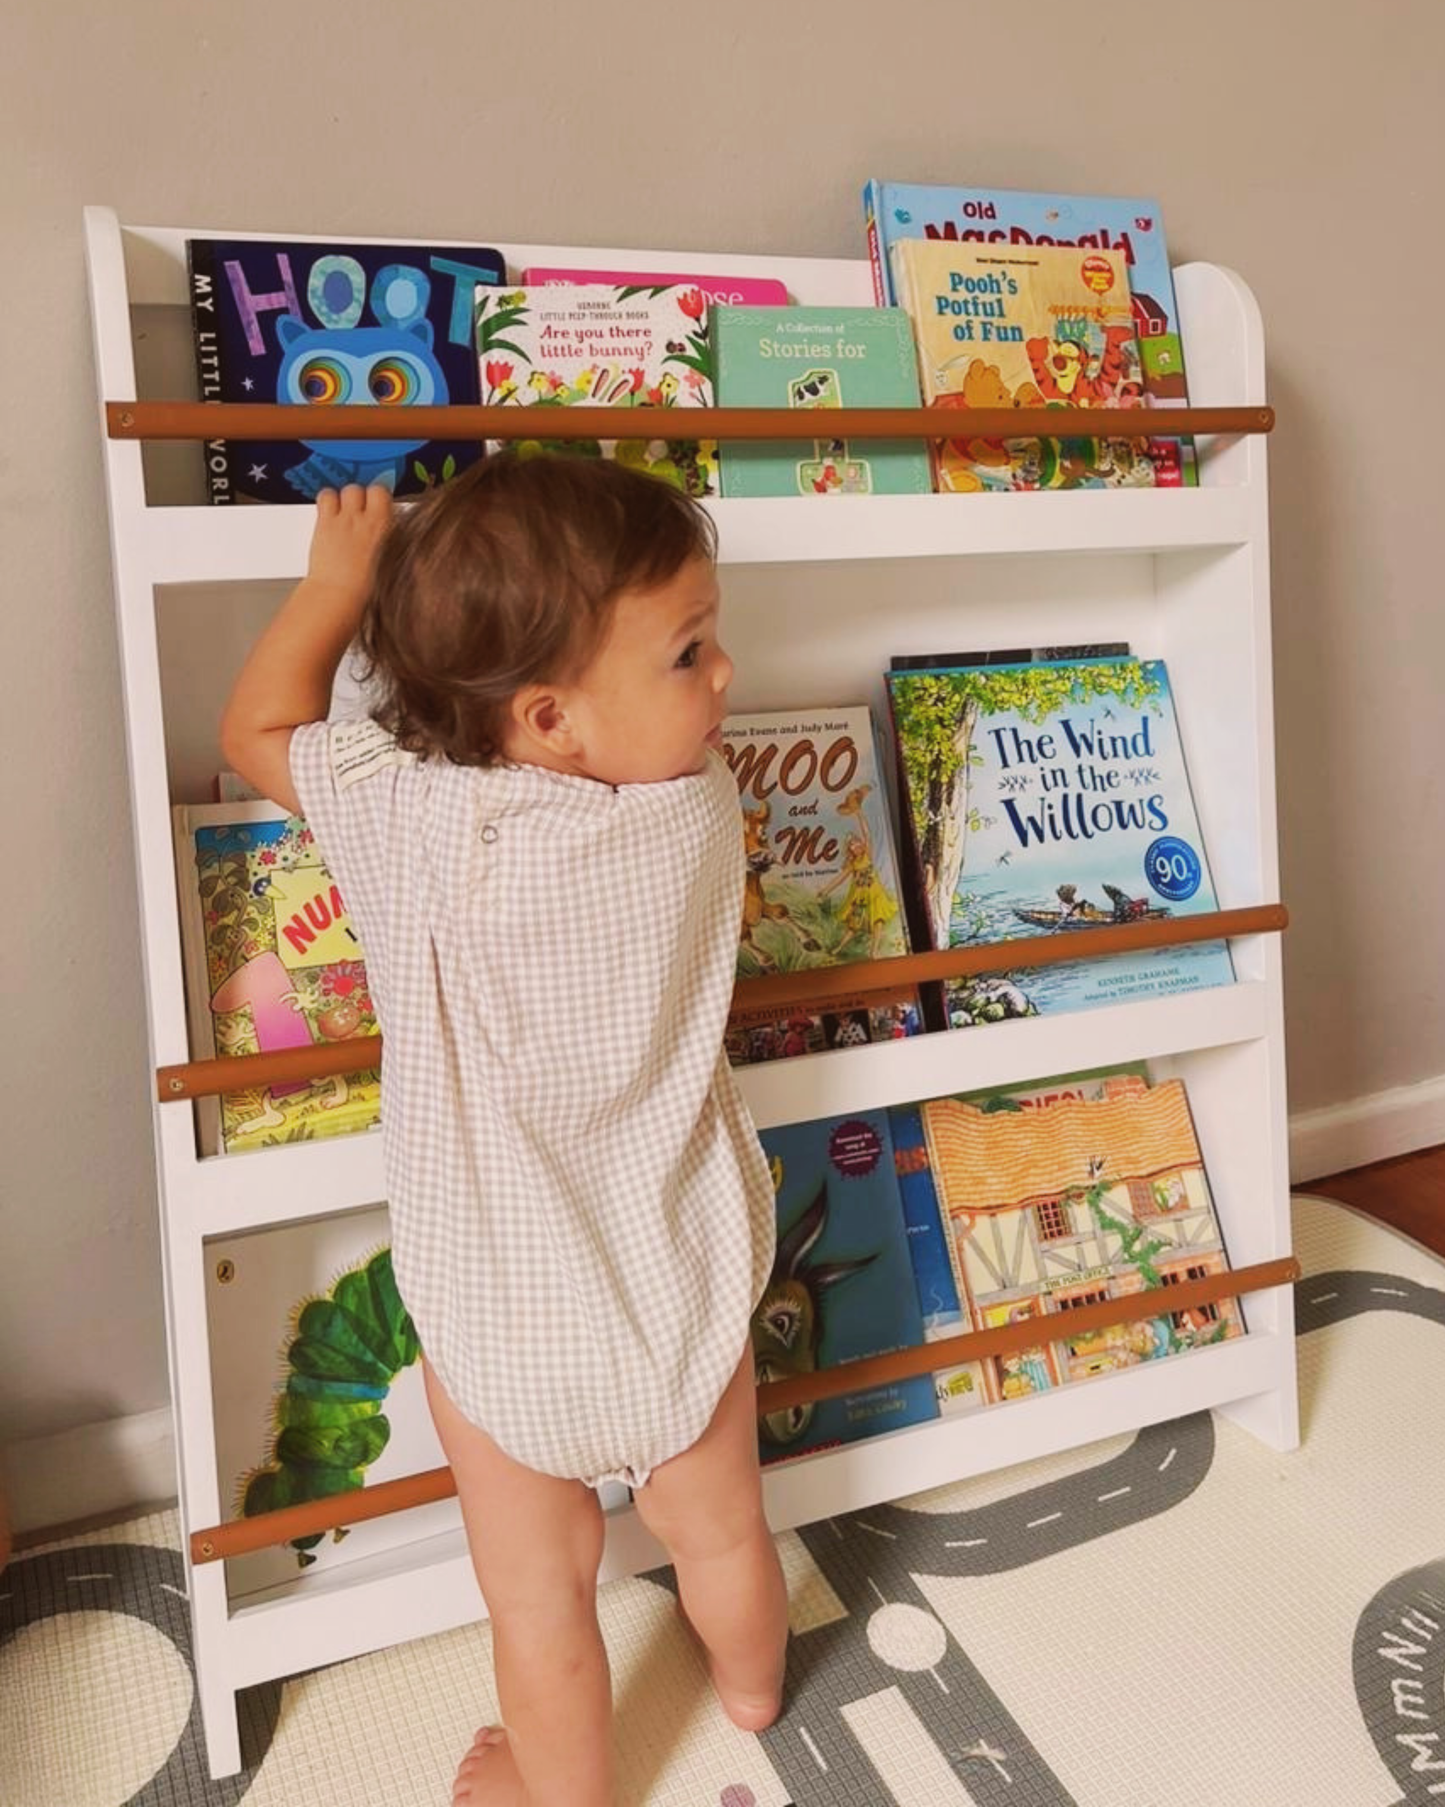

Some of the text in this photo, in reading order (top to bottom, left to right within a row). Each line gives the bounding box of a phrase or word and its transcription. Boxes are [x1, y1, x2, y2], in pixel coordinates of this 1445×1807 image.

[963, 202, 996, 219] Old
[195, 274, 214, 312] MY
[949, 271, 1019, 295] Pooh's
[223, 253, 499, 356] HOOT
[936, 296, 1006, 318] Potful
[540, 312, 566, 321] LITTLE
[775, 322, 845, 334] A Collection of
[539, 324, 652, 343] Are you there
[953, 319, 1025, 342] of Fun
[540, 340, 654, 362] little bunny?
[759, 338, 867, 358] Stories for
[200, 332, 222, 404] LITTL
[780, 725, 798, 735] and
[801, 722, 823, 734] Judy
[987, 715, 1156, 769] The Wind
[1040, 763, 1121, 793] in the
[788, 798, 819, 817] and
[999, 792, 1169, 848] Willows
[774, 825, 840, 865] Me
[1155, 855, 1188, 884] 90
